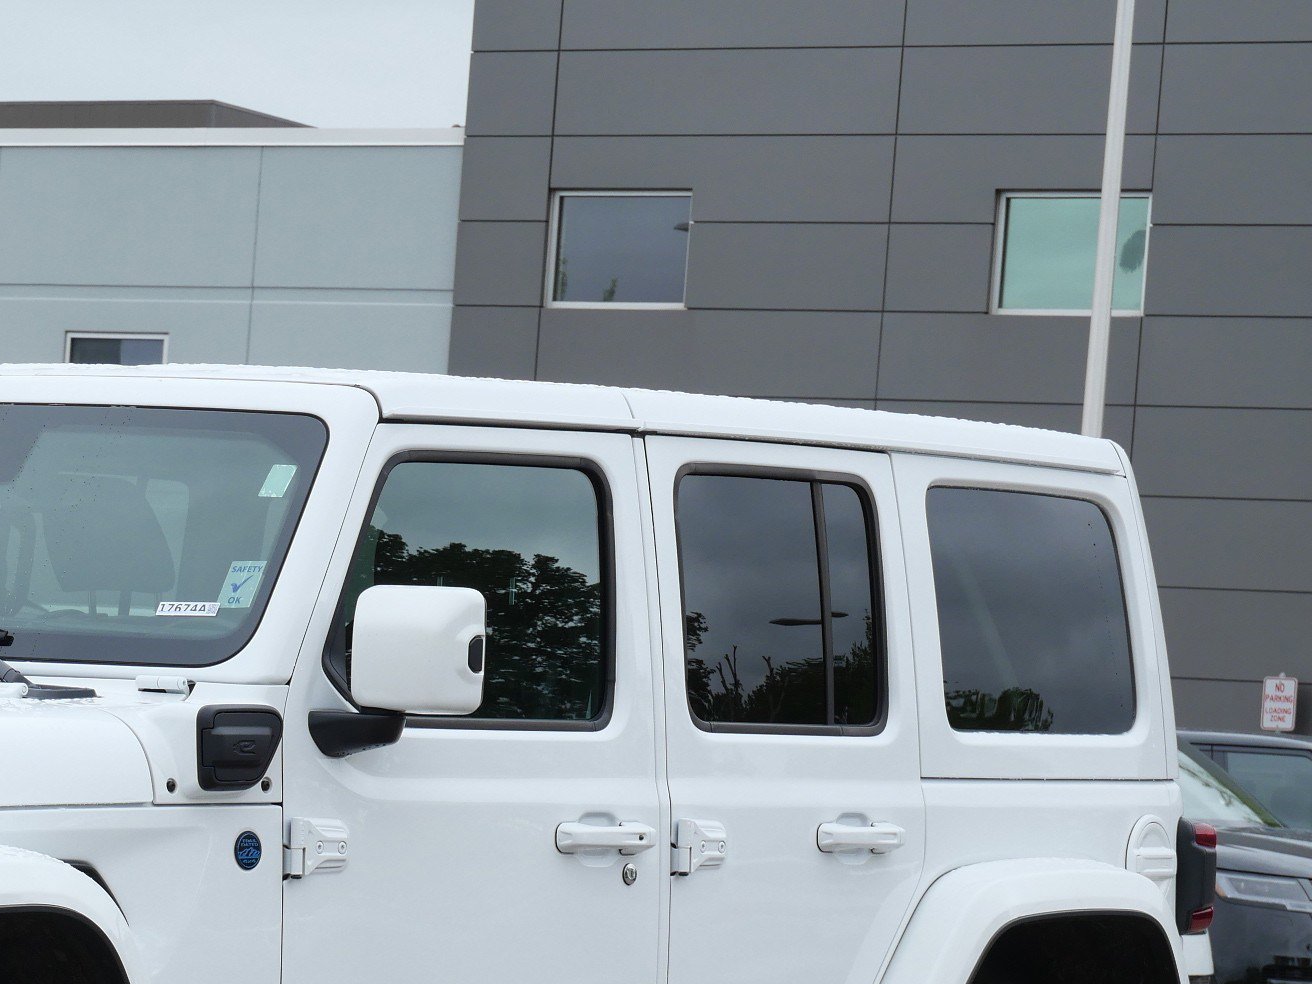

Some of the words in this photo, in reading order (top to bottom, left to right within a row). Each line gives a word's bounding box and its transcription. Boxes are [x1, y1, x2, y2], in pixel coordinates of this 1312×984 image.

[228, 596, 241, 605] OK
[1275, 682, 1285, 693] NO
[1264, 694, 1294, 704] PARKING
